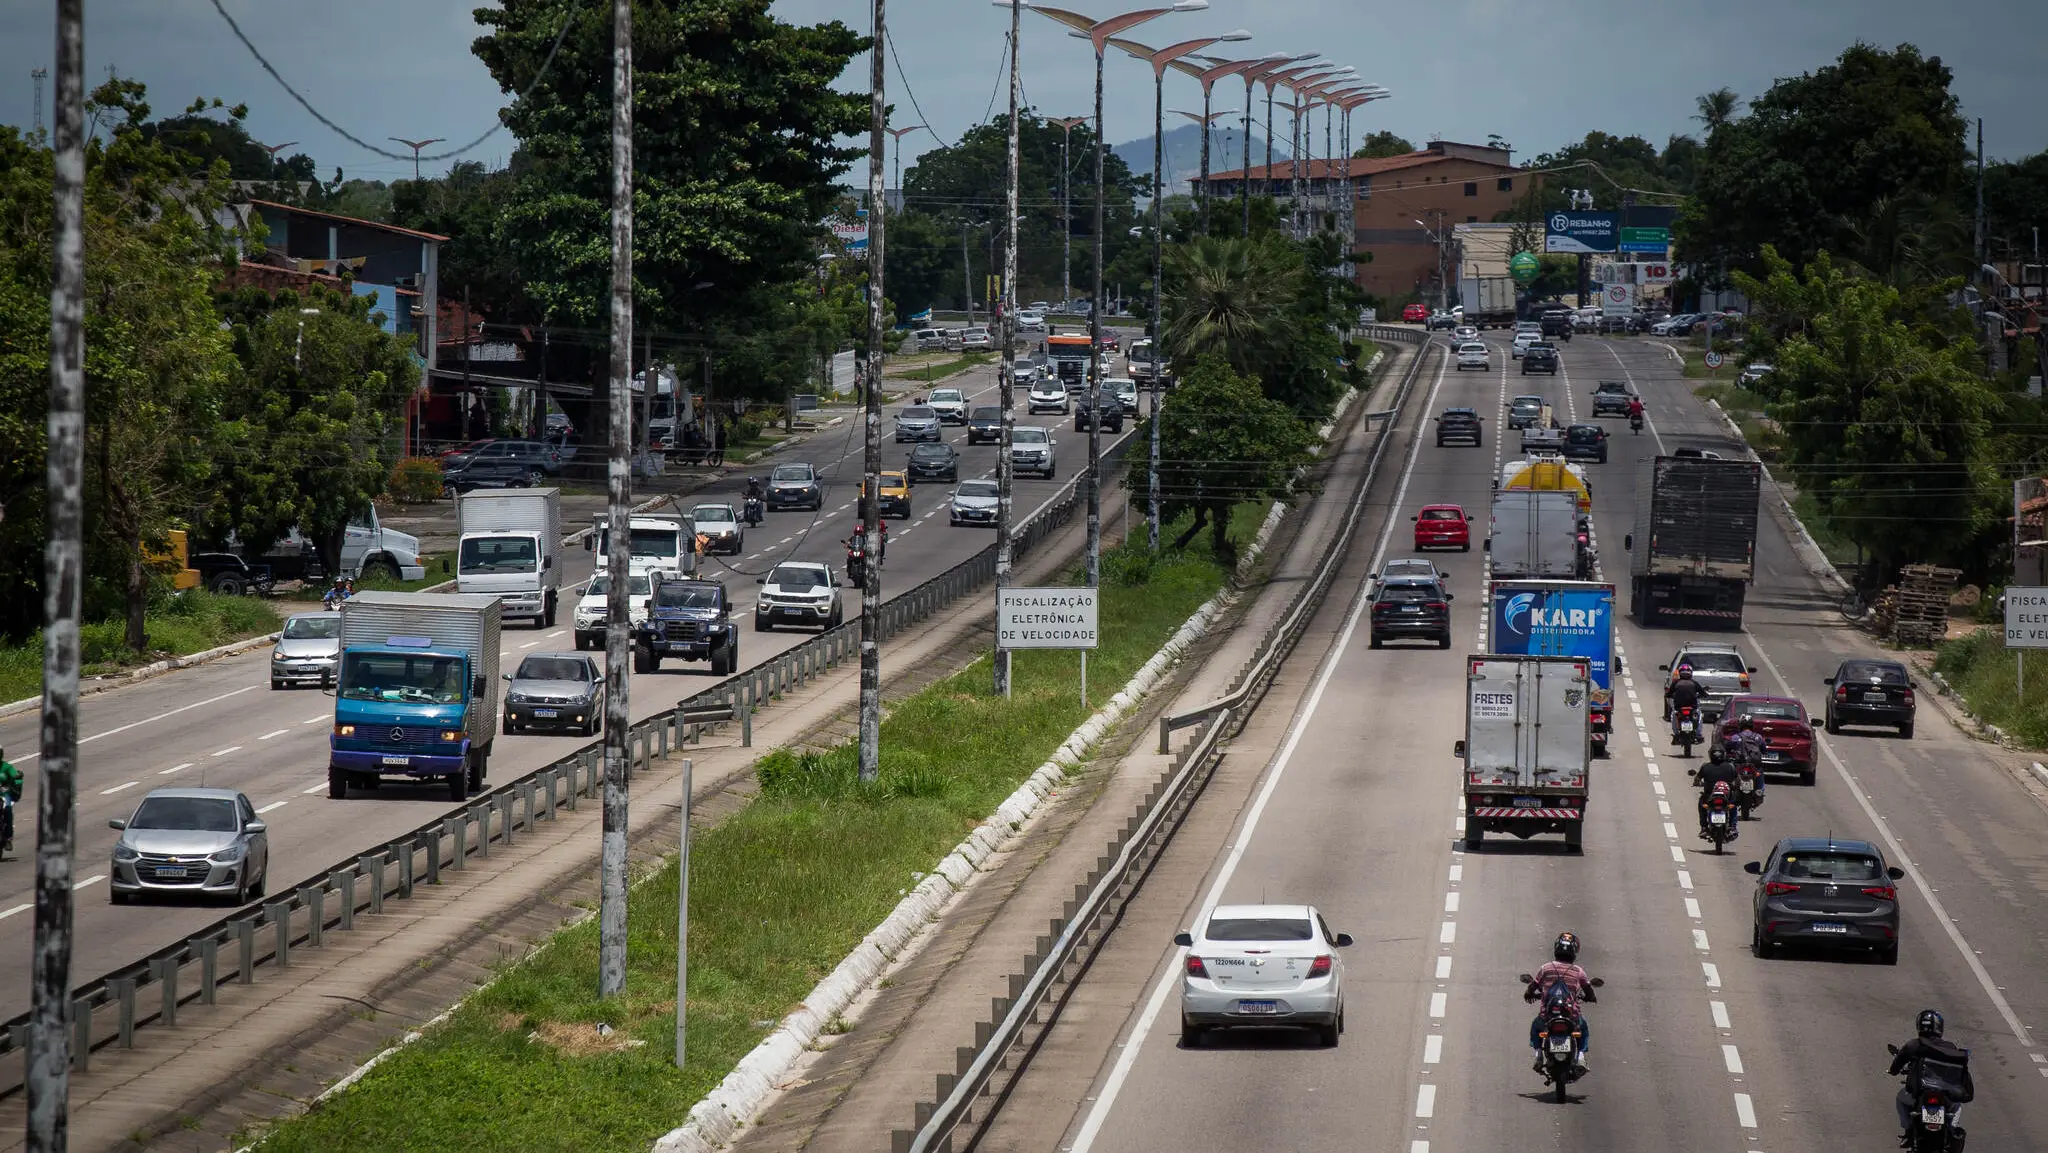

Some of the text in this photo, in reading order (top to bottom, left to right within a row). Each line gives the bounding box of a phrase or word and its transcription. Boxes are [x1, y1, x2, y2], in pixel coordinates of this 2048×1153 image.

[834, 224, 864, 232] Diesel
[1645, 266, 1666, 278] 10
[1708, 354, 1720, 362] 60
[1004, 596, 1092, 608] FISCALIZAÇÃO
[2012, 597, 2048, 606] FISCA
[1012, 612, 1084, 624] ELETRÔNICA
[1532, 608, 1596, 627] KARI
[1002, 630, 1094, 640] DE VELOCIDADE
[2008, 630, 2022, 639] DE
[1474, 694, 1512, 704] FRETES
